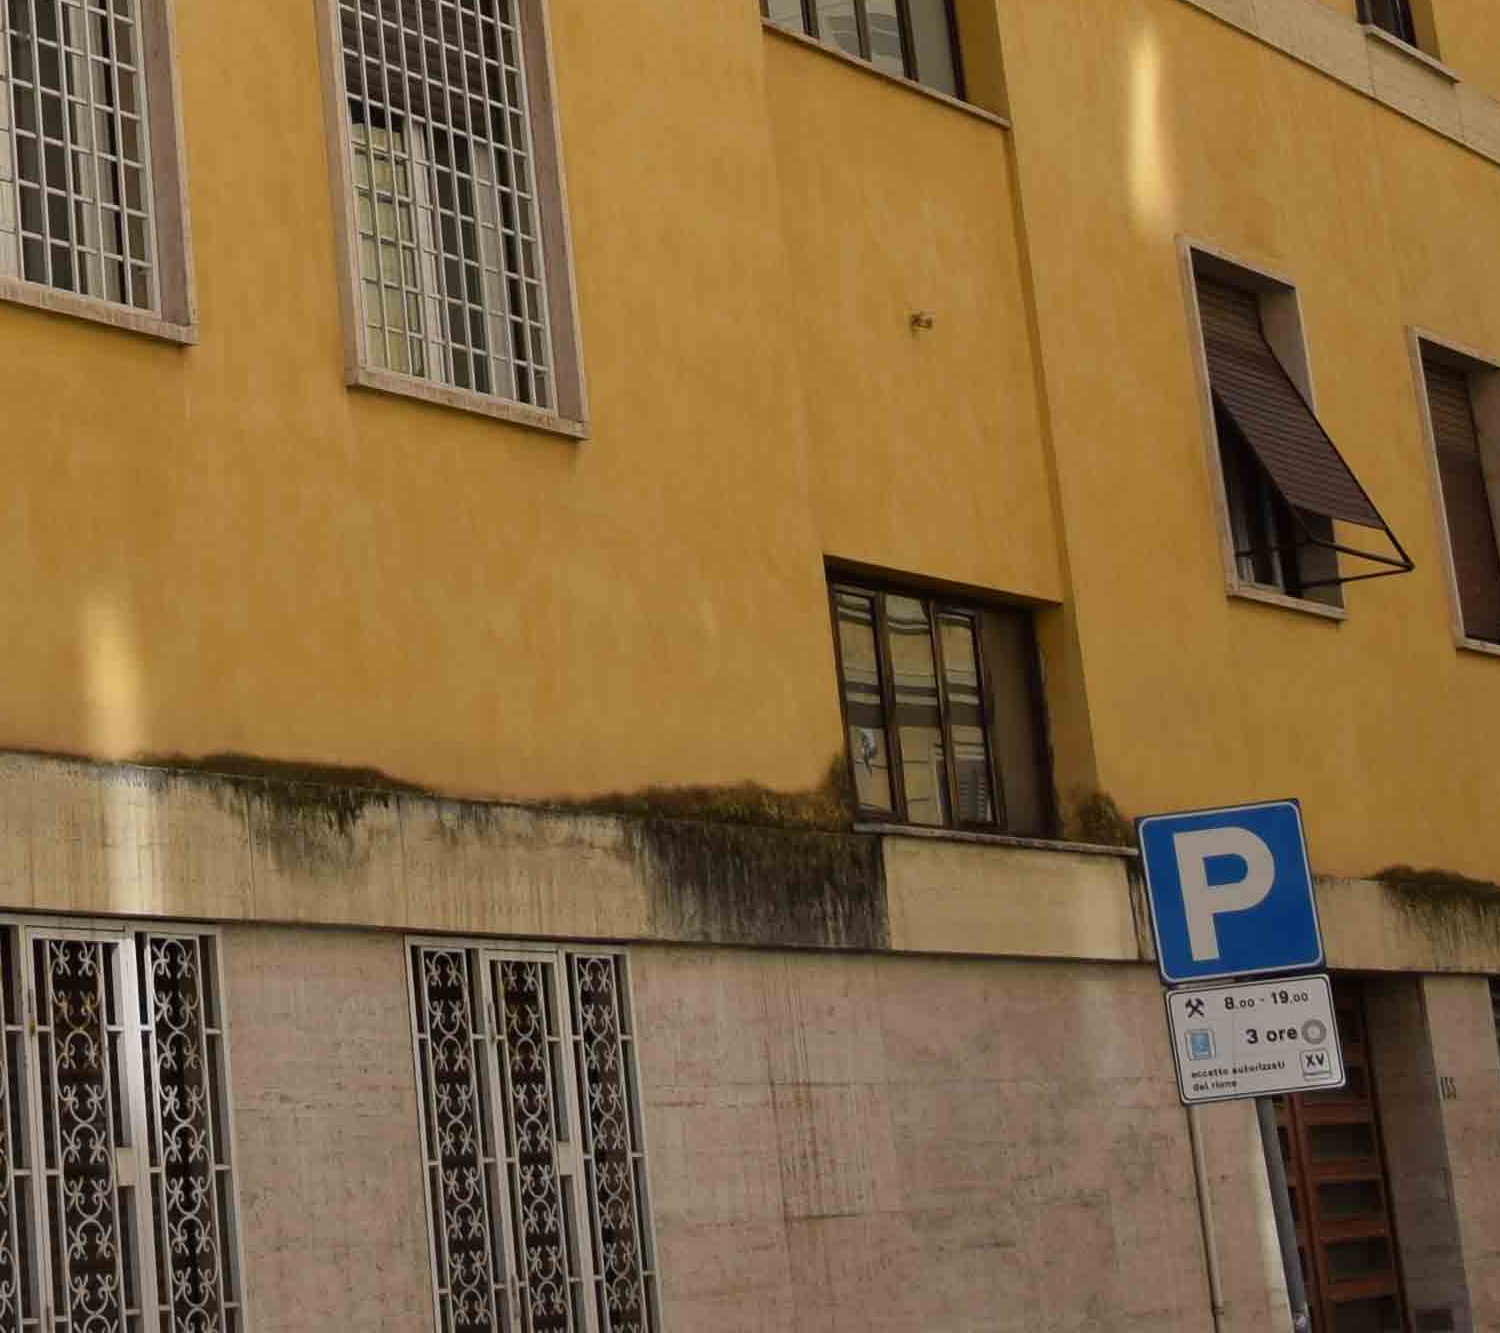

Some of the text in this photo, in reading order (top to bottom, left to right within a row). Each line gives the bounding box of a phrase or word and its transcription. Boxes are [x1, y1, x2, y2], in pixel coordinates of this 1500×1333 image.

[1173, 826, 1275, 961] P
[1224, 996, 1255, 1010] 8.00
[1271, 990, 1308, 1005] 19.00
[1246, 1027, 1298, 1044] 3 ore
[1305, 1053, 1325, 1068] XV
